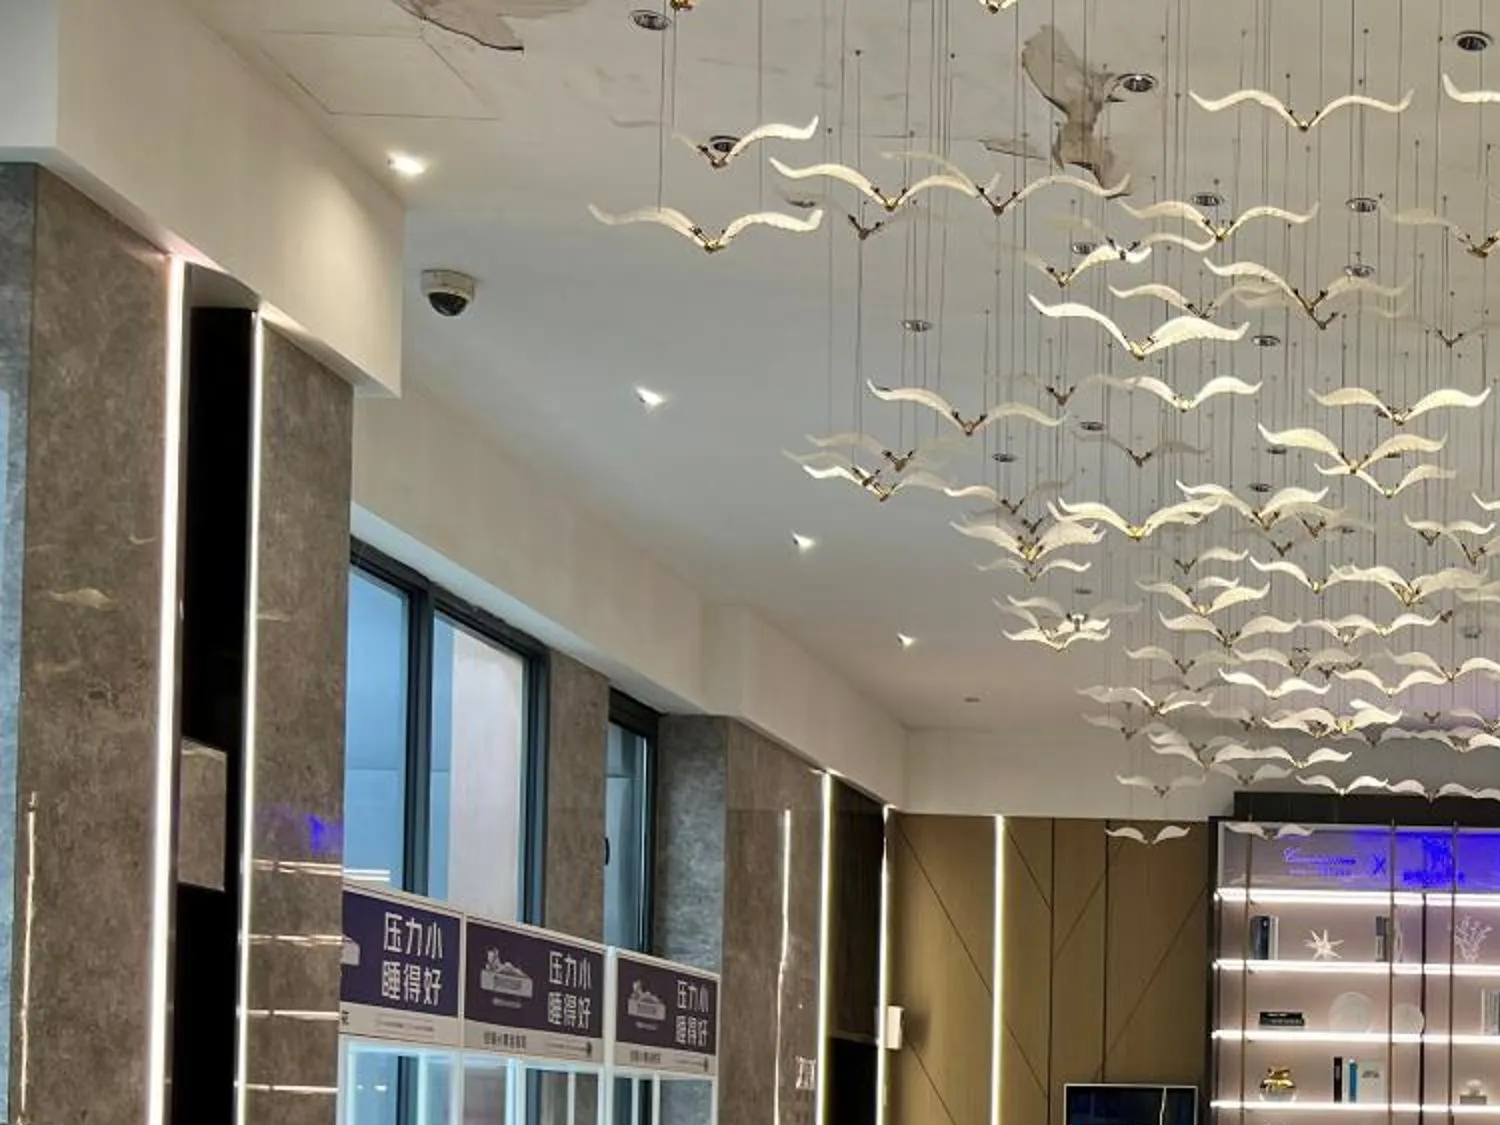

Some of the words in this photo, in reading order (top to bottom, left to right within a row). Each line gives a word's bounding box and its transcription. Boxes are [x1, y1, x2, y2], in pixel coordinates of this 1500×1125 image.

[383, 911, 443, 960] 压力小
[381, 959, 443, 1006] 睡得好
[548, 950, 592, 990] 压力小
[547, 991, 592, 1030] 睡得好
[676, 980, 709, 1012] 压力小
[674, 1014, 708, 1047] 睡得好
